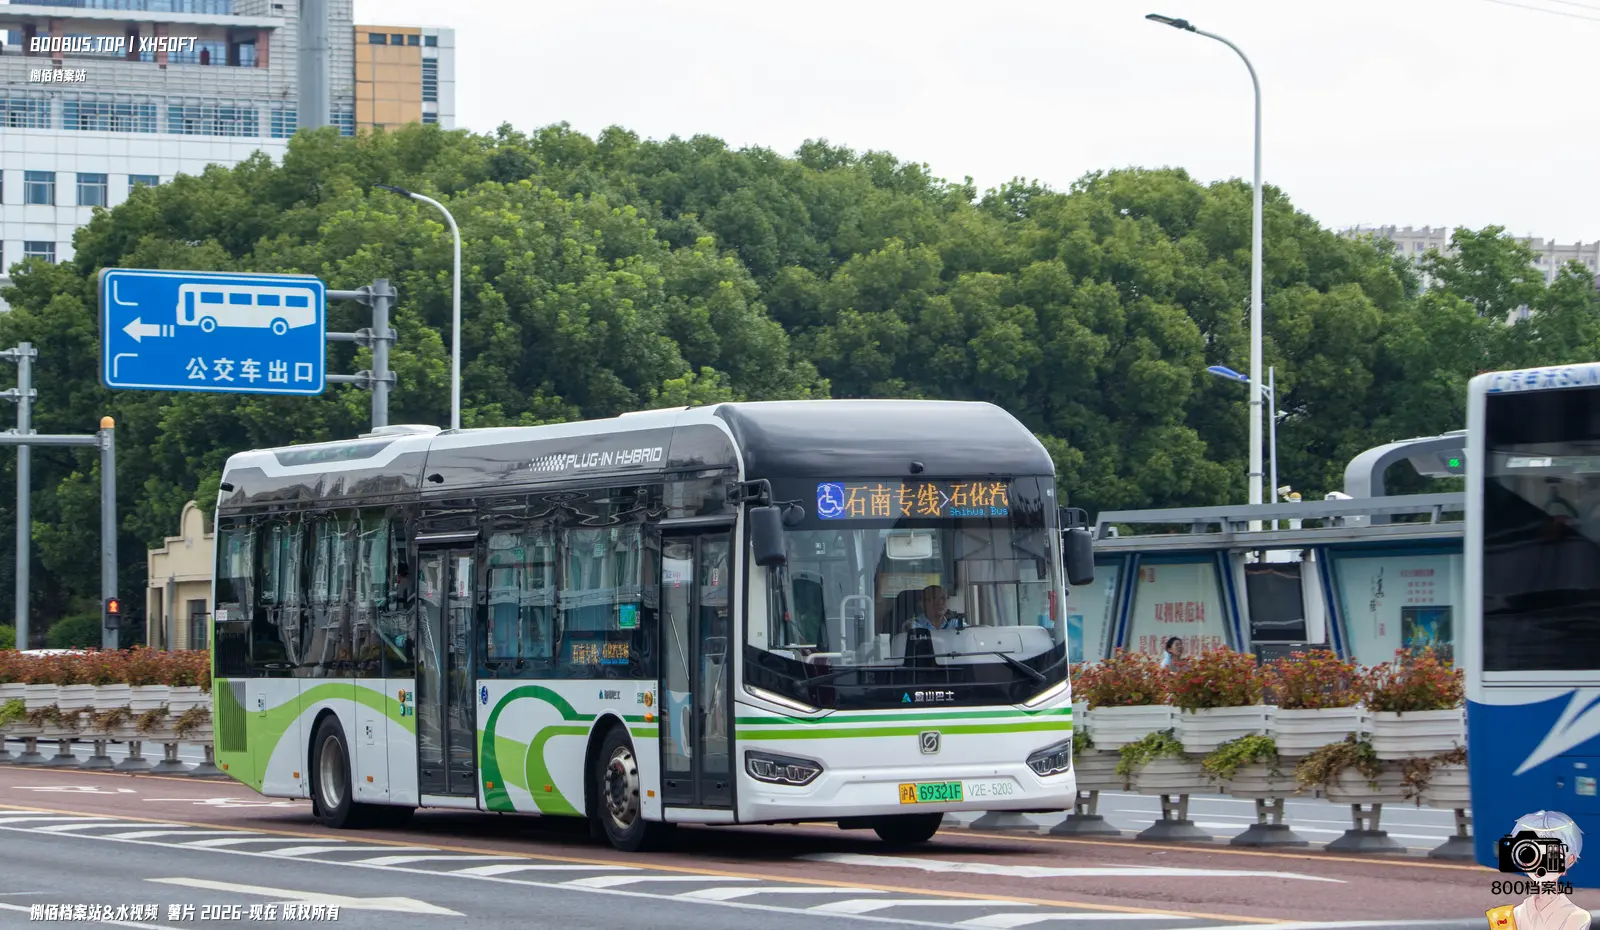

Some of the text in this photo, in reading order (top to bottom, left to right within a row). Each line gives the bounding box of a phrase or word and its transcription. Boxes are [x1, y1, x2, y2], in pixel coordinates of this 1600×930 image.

[185, 357, 313, 383] 公交车出口
[615, 447, 663, 465] HYBRID
[845, 482, 1009, 517] 石南专线 石化汽
[950, 506, 1008, 516] Shihua Bus
[914, 690, 955, 702] 金山巴士
[920, 784, 961, 801] 69321F
[968, 782, 1013, 797] V2E-5203
